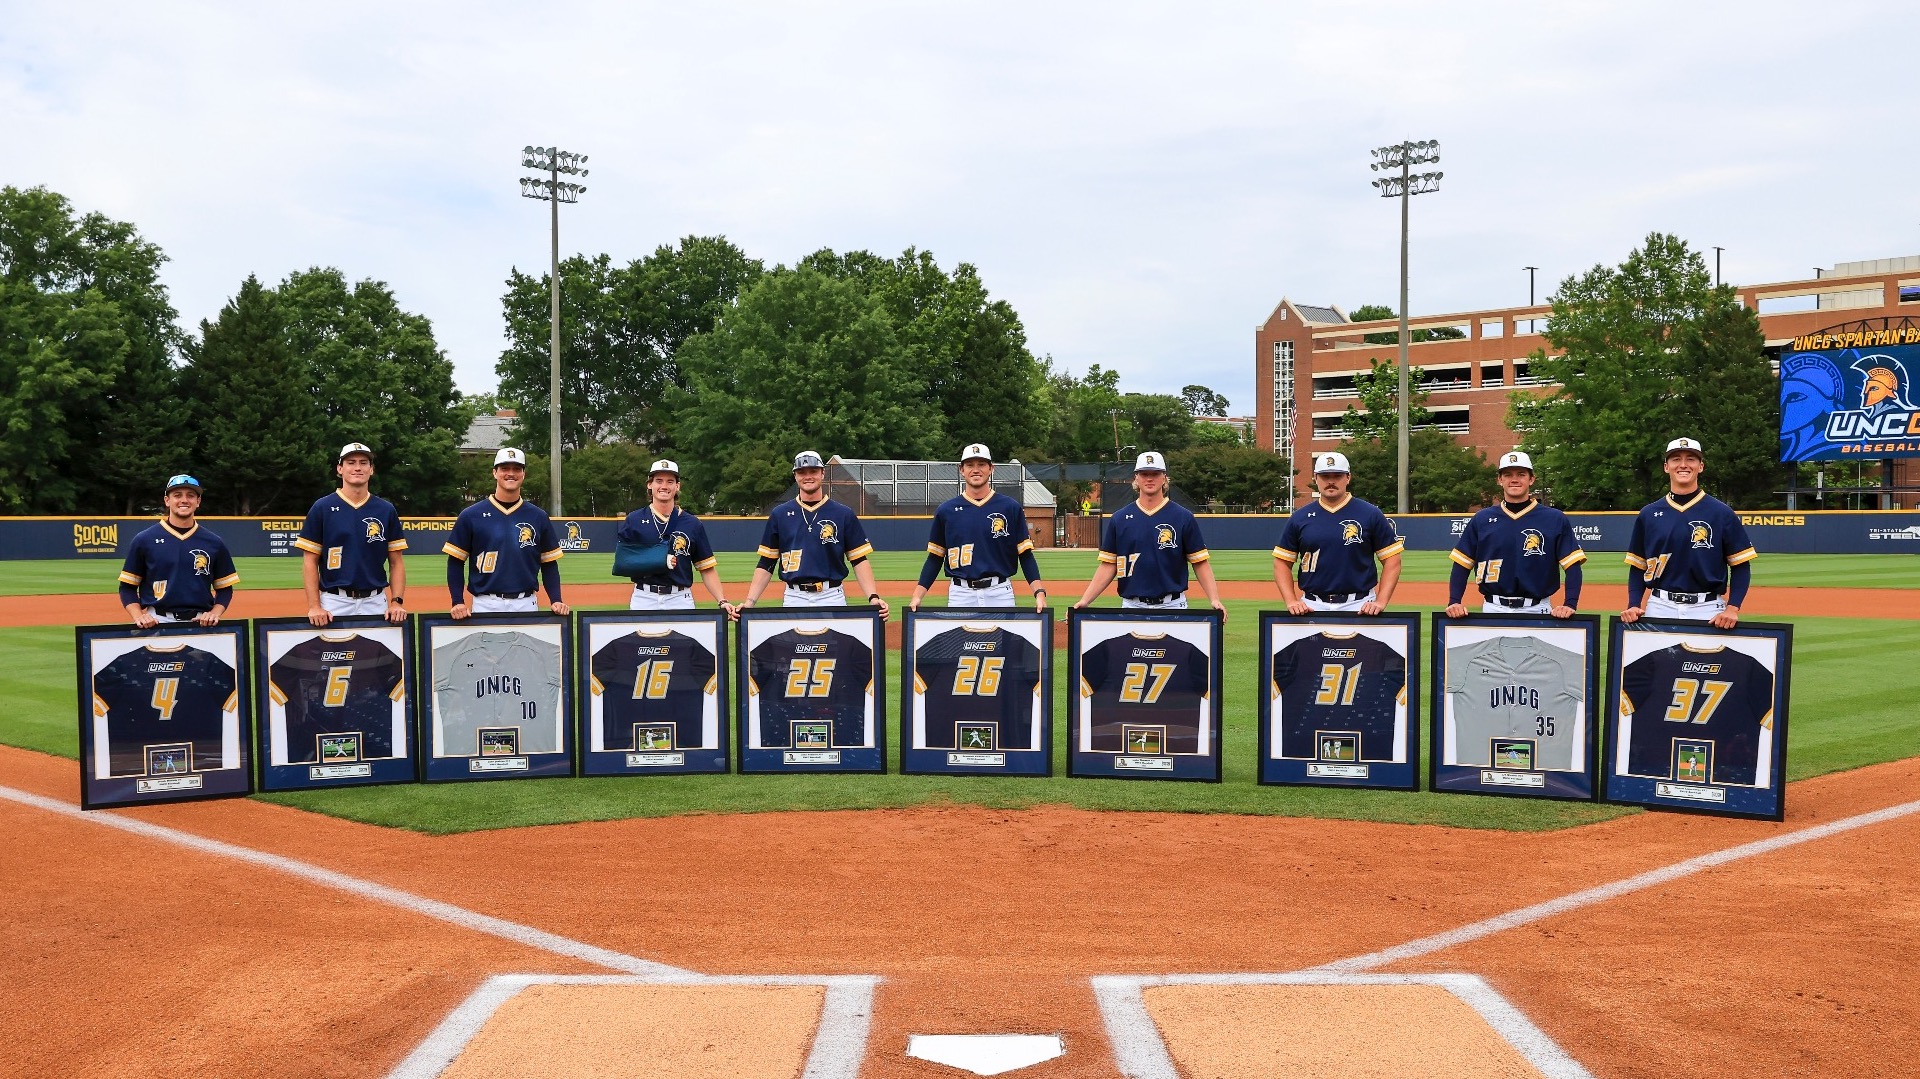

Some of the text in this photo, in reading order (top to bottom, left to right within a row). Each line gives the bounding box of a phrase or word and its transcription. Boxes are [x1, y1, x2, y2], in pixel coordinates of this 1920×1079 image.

[1793, 334, 1832, 351] UNCG
[1835, 328, 1902, 348] SPARTAN
[1741, 515, 1805, 526] RANCES
[559, 539, 590, 550] UNCG
[948, 543, 974, 570] 26
[326, 545, 344, 570] 6
[476, 550, 498, 574] 10
[1116, 552, 1141, 578] 27
[320, 650, 357, 662] UNCG
[637, 645, 671, 656] UNCG
[794, 643, 828, 654] UNCG
[963, 641, 997, 652] UNCG
[1131, 647, 1166, 659] UNCG
[1322, 647, 1357, 659] UNCG
[147, 661, 186, 673] UNCG
[631, 657, 675, 700] 16
[784, 658, 837, 698] 25
[951, 655, 1006, 697] 26
[1681, 661, 1722, 675] UNCG
[322, 665, 353, 708] 6
[475, 674, 522, 699] UNCG
[1118, 662, 1178, 703] 27
[1314, 661, 1363, 706] 31
[150, 677, 180, 721] 4
[1489, 684, 1539, 711] UNCG
[1663, 677, 1734, 725] 37
[519, 700, 537, 721] 10
[1535, 716, 1556, 738] 35
